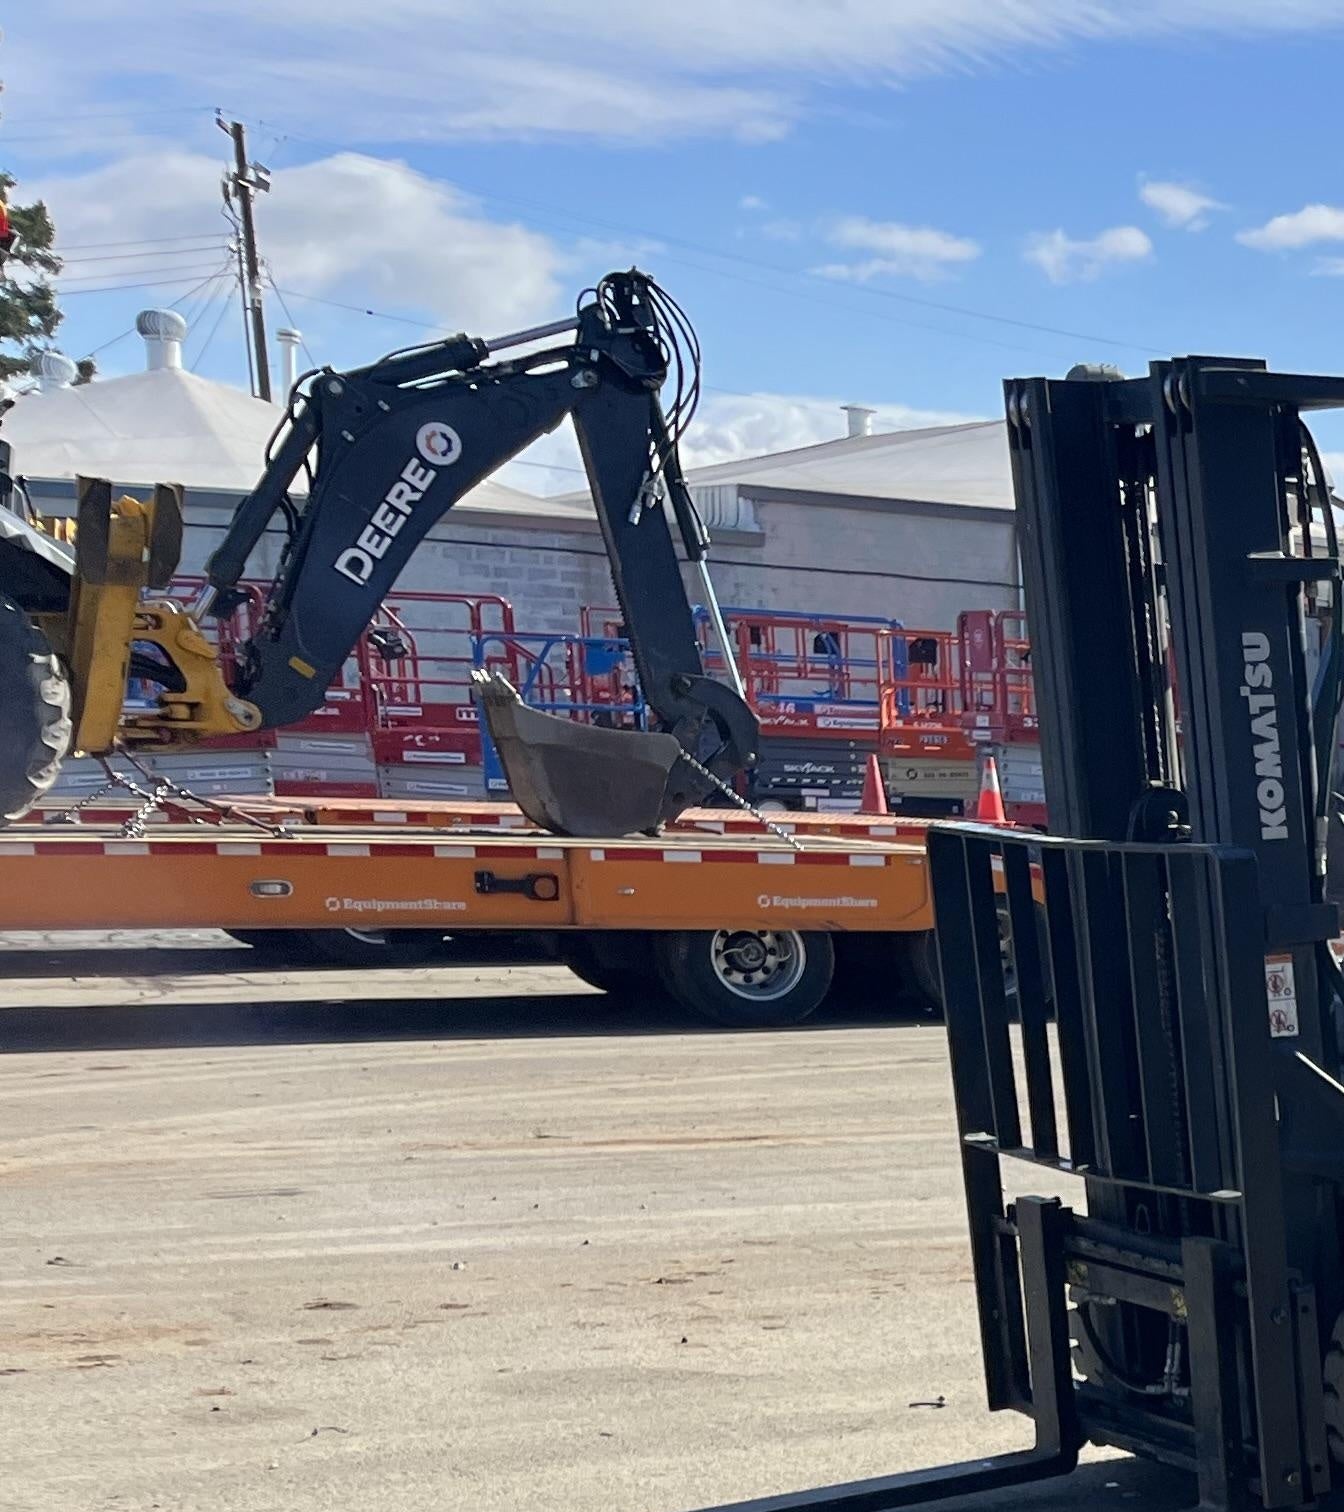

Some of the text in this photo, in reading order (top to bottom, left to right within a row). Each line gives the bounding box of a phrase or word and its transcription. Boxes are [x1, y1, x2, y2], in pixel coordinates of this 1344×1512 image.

[333, 457, 438, 586] DEERE
[1239, 631, 1289, 840] KOMATSU
[343, 897, 467, 911] EquipmentShare
[772, 896, 878, 909] EquipmentShare
